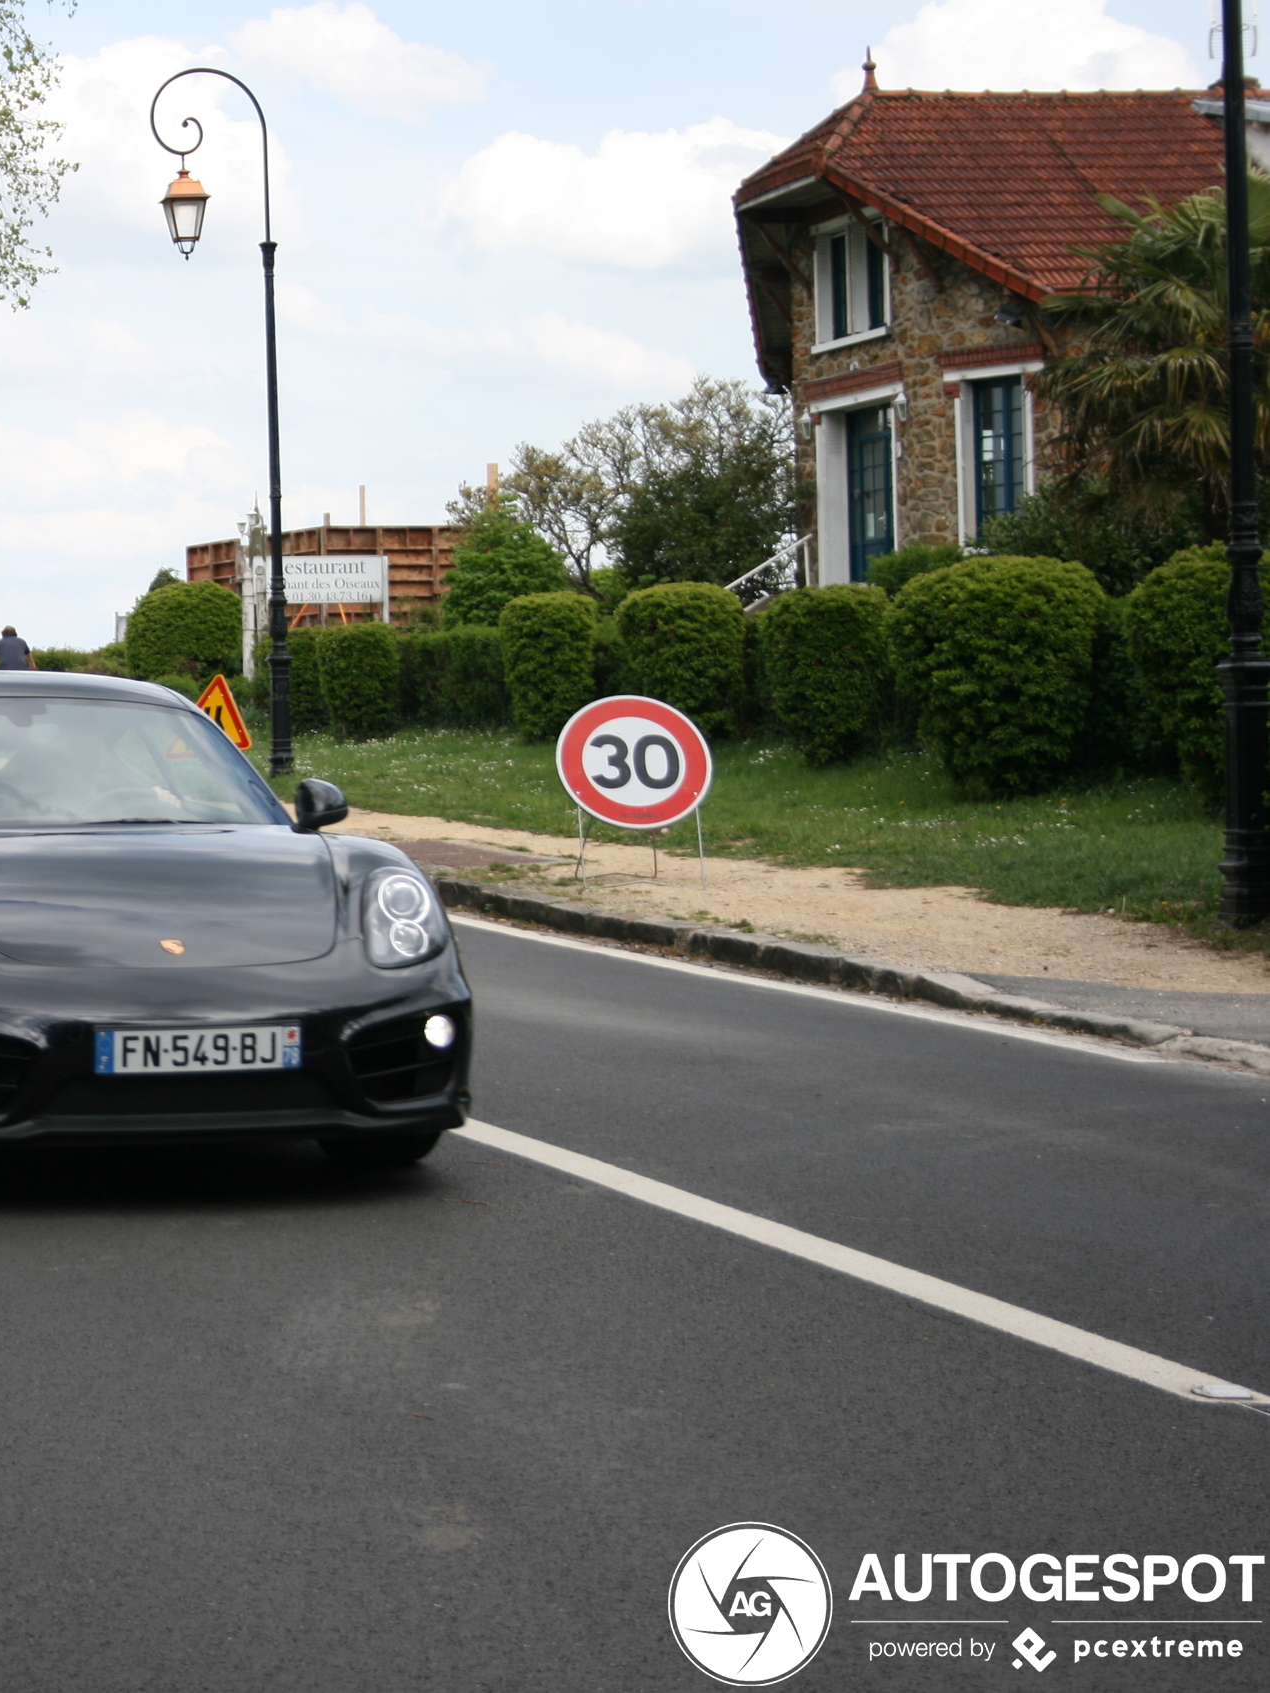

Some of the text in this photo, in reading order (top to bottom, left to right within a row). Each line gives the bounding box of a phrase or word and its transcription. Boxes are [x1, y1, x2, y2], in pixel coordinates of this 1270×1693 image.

[283, 560, 366, 575] estaurant
[284, 578, 308, 589] hant
[311, 578, 331, 589] des
[334, 577, 380, 589] Oiseaux
[589, 734, 680, 789] 30
[122, 1031, 276, 1068] FN-549-BJ
